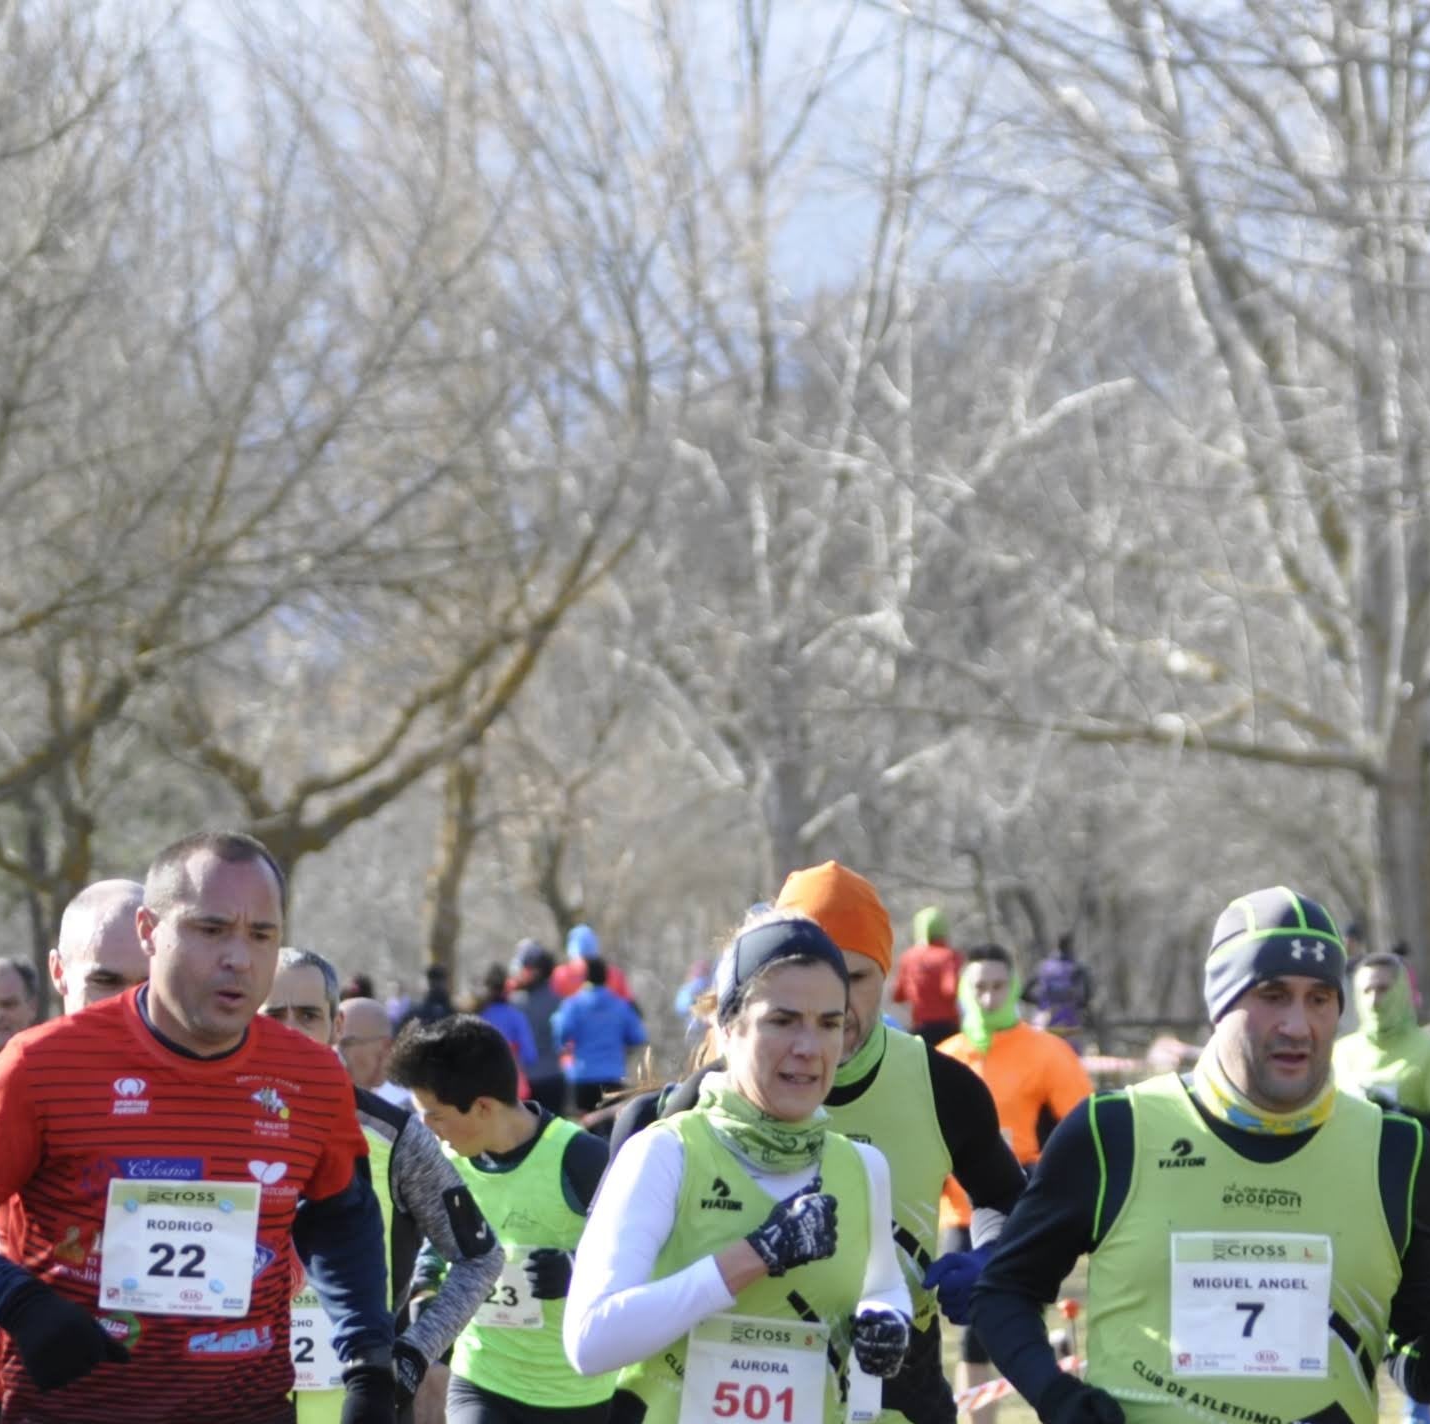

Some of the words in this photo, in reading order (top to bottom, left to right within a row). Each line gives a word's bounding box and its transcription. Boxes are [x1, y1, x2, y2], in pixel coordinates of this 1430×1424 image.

[1158, 1157, 1206, 1169] VIATOR
[1222, 1191, 1302, 1208] ecosport
[146, 1219, 213, 1233] RODRIGO
[147, 1243, 206, 1278] 22
[1193, 1277, 1251, 1290] MIGUEL
[1258, 1278, 1309, 1291] ANGEL
[293, 1295, 319, 1305] oss
[483, 1285, 520, 1307] 23
[290, 1319, 314, 1328] CHO
[1235, 1302, 1265, 1339] 7
[294, 1336, 315, 1363] 2
[664, 1352, 685, 1377] CLU
[730, 1359, 790, 1375] AURORA
[1132, 1359, 1164, 1388] CLUB
[1166, 1382, 1188, 1399] DE
[712, 1381, 795, 1423] 501
